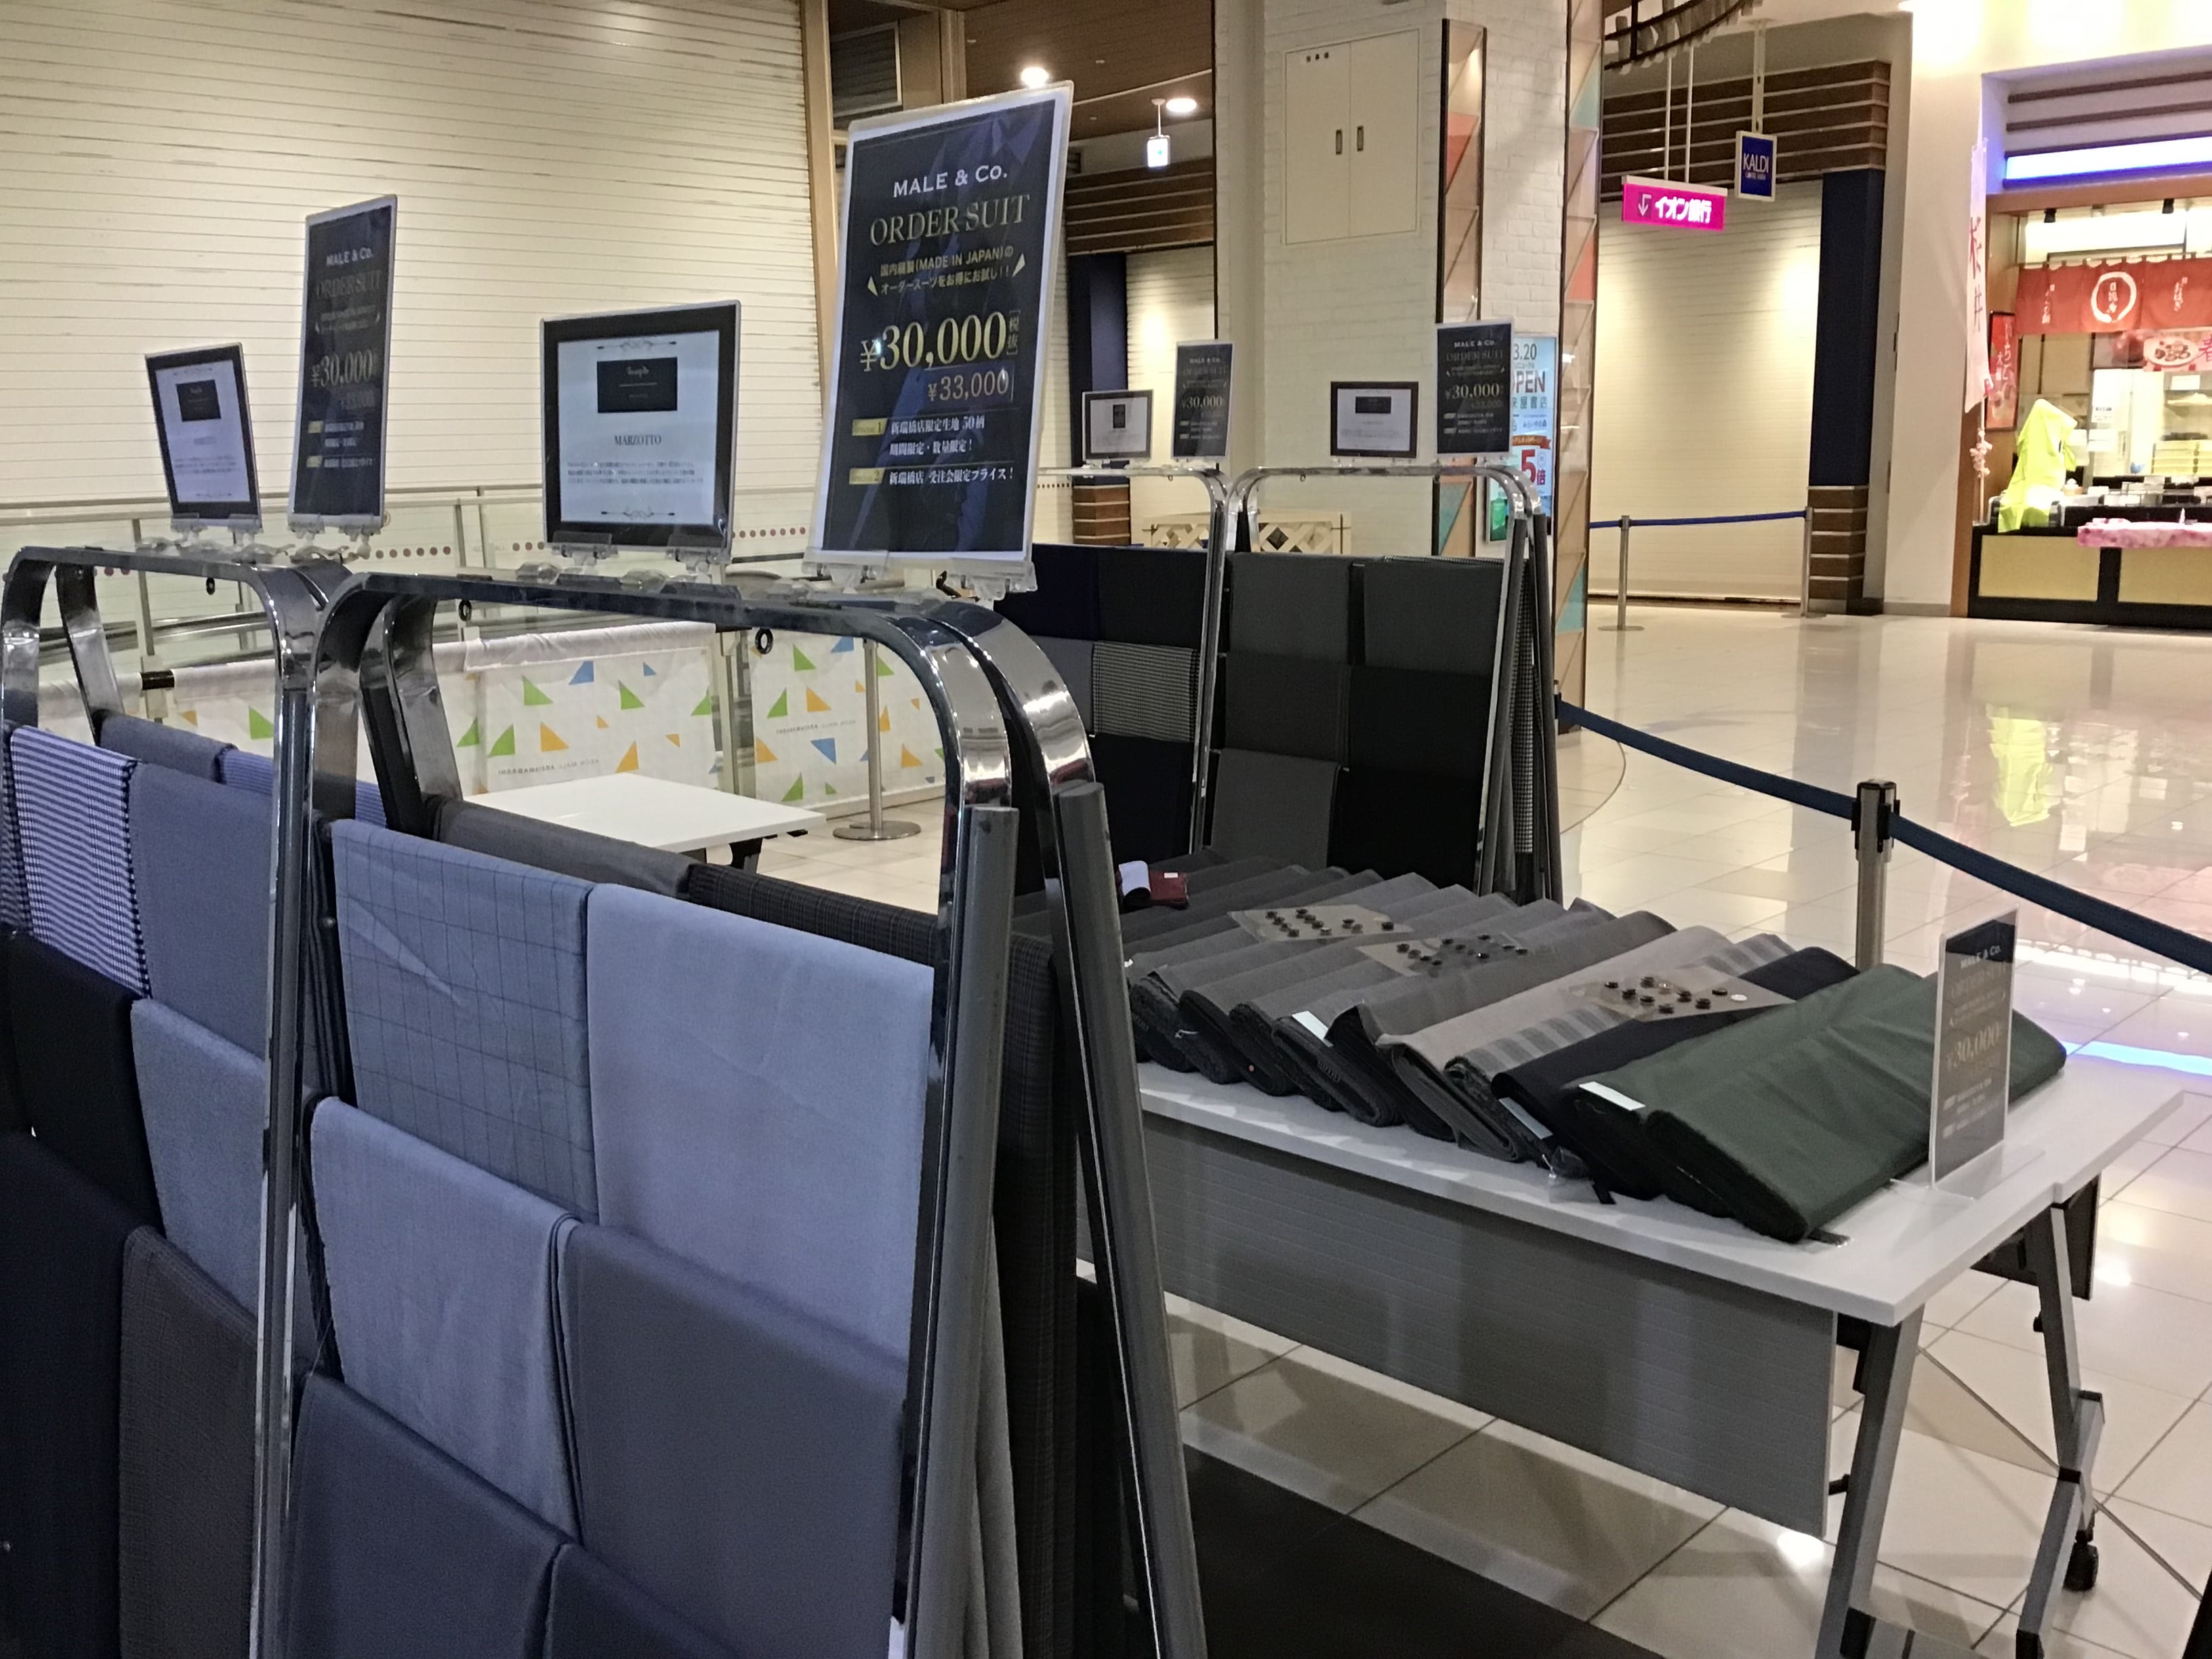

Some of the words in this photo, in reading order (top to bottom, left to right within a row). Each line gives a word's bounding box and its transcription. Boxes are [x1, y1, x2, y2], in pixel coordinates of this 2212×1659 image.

[1743, 153, 1769, 173] KALDI
[893, 172, 948, 198] MALE
[954, 169, 968, 186] &
[869, 205, 960, 247] ORDER
[965, 194, 1031, 232] SUIT
[1655, 196, 1713, 224] イオン銀行
[951, 253, 962, 266] IN
[859, 310, 1007, 373] ¥30,000
[1513, 343, 1537, 361] 3.20
[927, 369, 1010, 402] ¥33,000
[613, 434, 662, 446] MARZOTTO
